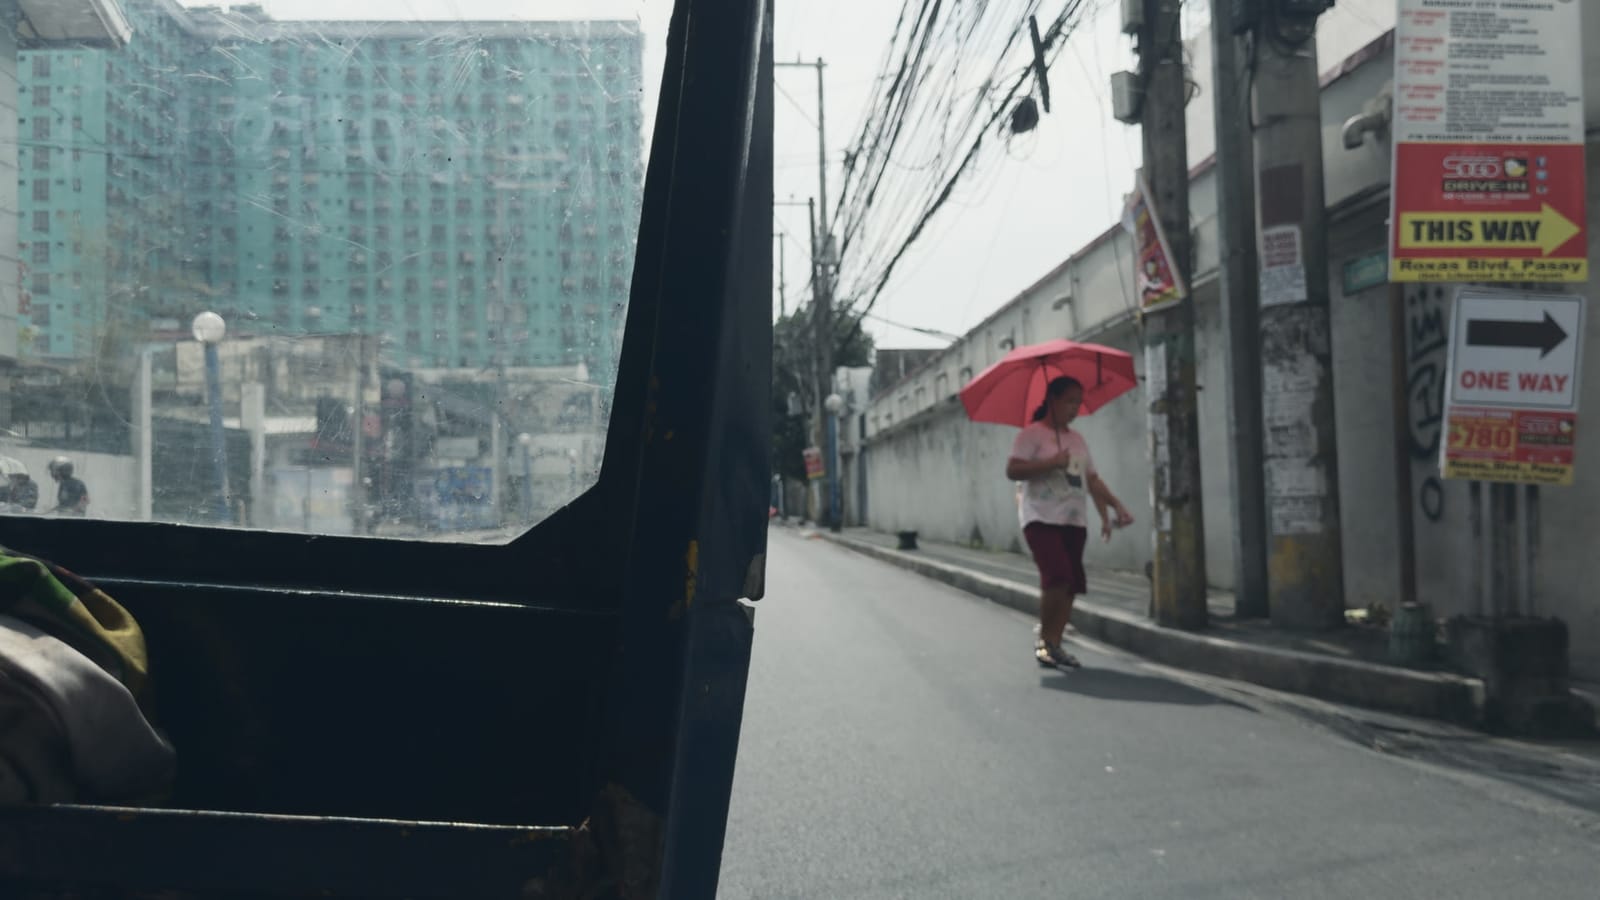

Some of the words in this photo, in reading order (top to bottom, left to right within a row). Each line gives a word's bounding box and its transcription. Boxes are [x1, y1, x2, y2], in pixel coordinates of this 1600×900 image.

[1442, 155, 1502, 178] SOGO
[1443, 181, 1528, 192] DRIVE-IN
[1410, 220, 1474, 241] THIS
[1480, 220, 1541, 241] WAY
[1400, 260, 1459, 271] Roxas
[1522, 259, 1582, 273] Pasay
[1459, 370, 1509, 391] ONE
[1518, 373, 1568, 393] WAY
